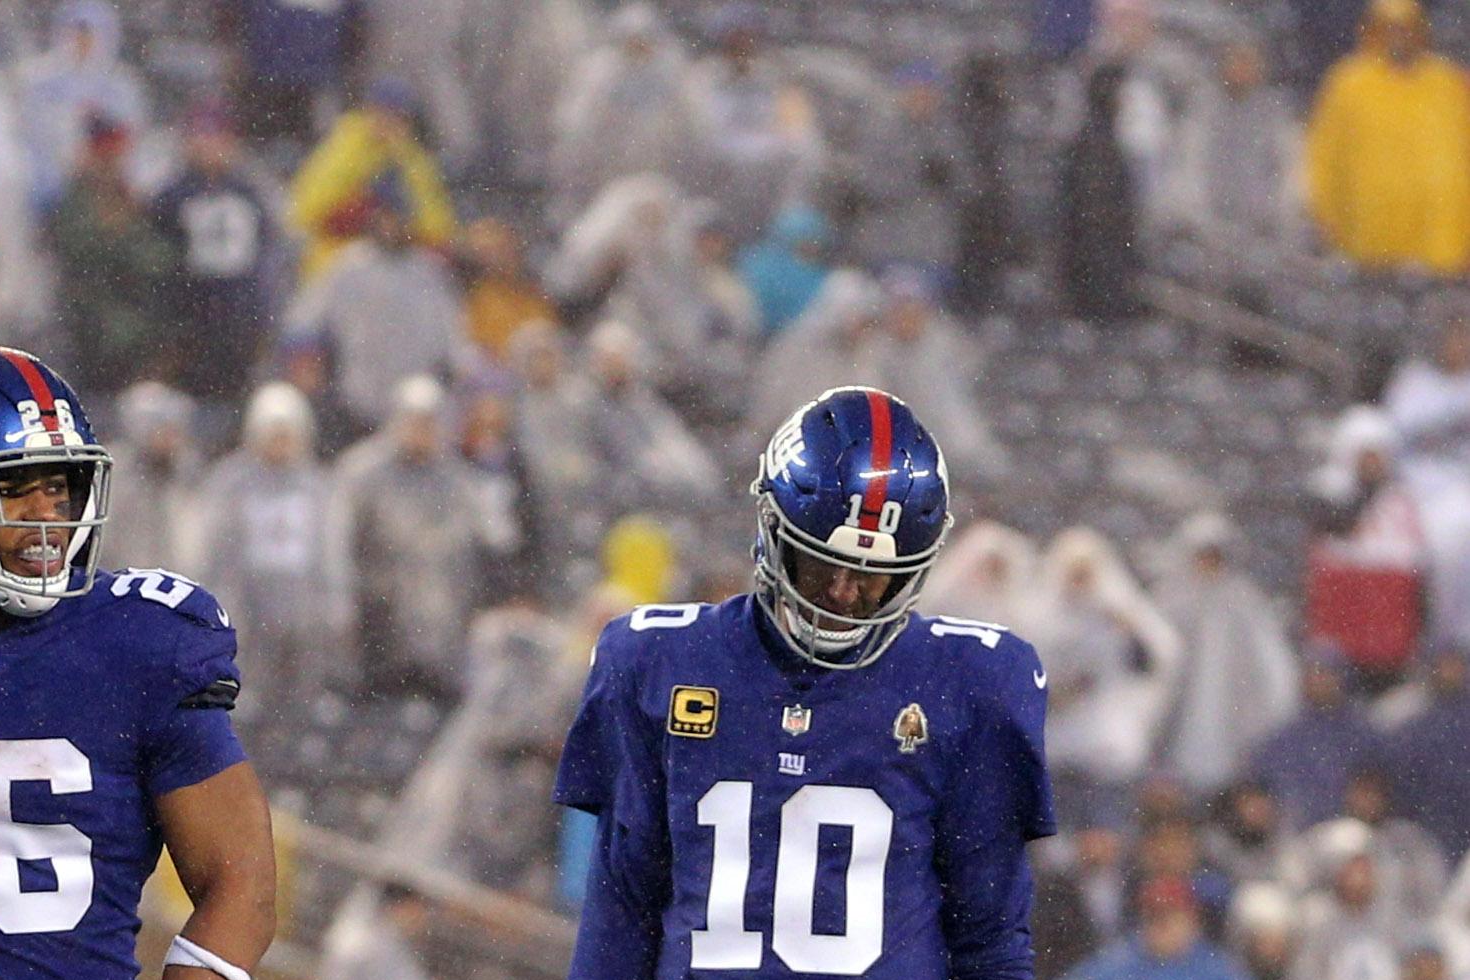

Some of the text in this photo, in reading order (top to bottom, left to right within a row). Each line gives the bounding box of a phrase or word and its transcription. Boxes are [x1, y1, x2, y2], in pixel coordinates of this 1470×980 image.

[17, 399, 76, 435] 26
[844, 493, 902, 534] 10
[674, 690, 715, 723] C
[778, 752, 805, 776] ny
[690, 781, 894, 975] 10
